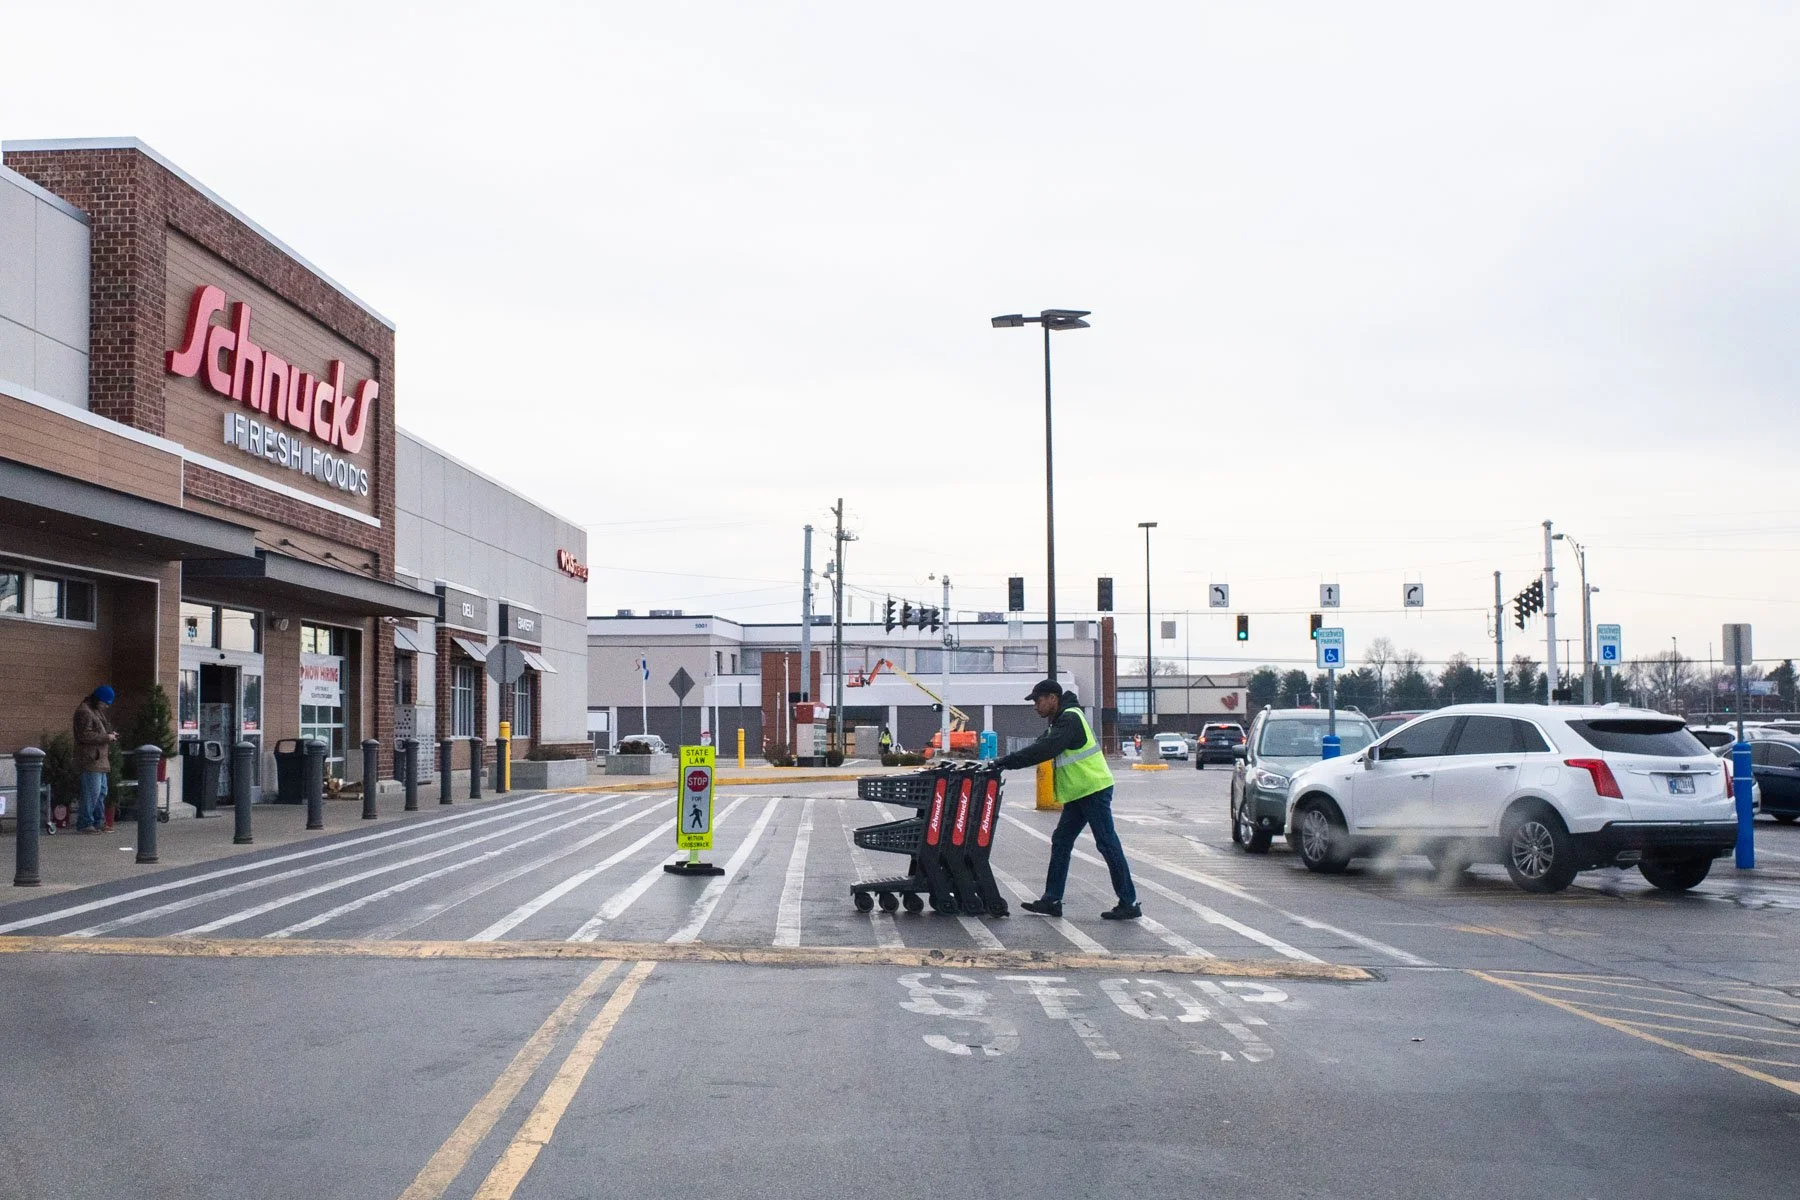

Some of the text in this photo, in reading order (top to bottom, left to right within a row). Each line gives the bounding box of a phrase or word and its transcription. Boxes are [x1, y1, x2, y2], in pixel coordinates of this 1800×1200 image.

[166, 285, 379, 454] Schnucks
[224, 412, 368, 496] FRESH FOODS
[462, 602, 474, 618] DELI
[517, 616, 534, 632] BAKERY
[304, 664, 338, 683] NOW HIRING
[686, 749, 709, 757] STATE
[689, 757, 706, 765] LAW
[688, 776, 708, 786] STOP
[931, 791, 943, 833] Schnucks
[957, 791, 968, 833] Schnucks
[982, 793, 993, 834] Schnucks
[897, 972, 1290, 1062] STOP
